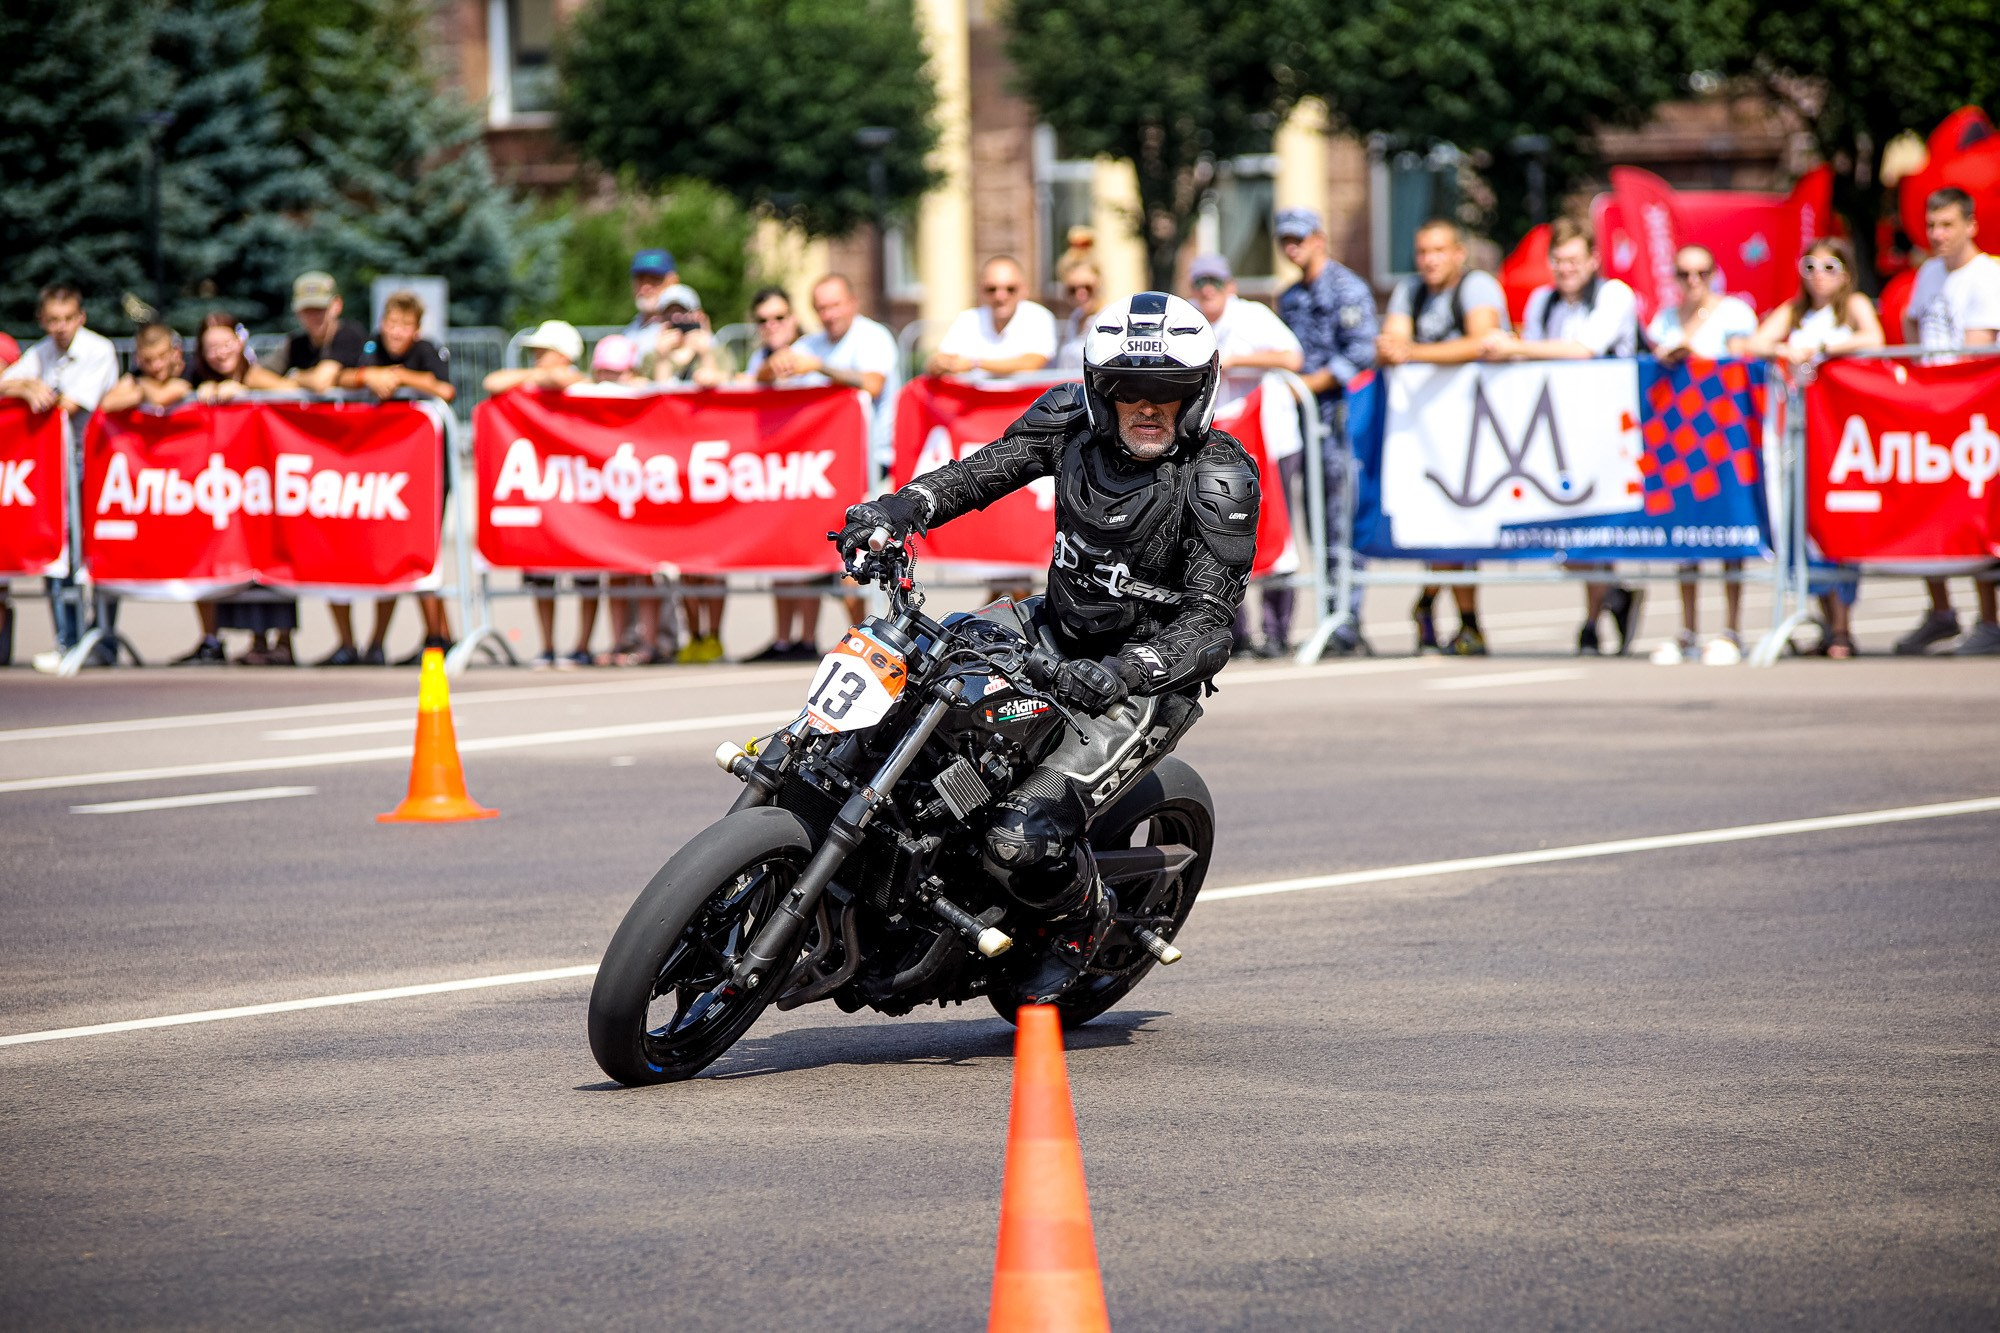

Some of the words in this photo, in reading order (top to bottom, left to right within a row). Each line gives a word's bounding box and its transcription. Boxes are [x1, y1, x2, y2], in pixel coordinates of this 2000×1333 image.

[1127, 340, 1162, 353] SHOEI
[0, 458, 36, 507] к
[492, 437, 682, 519] Альфа
[687, 440, 837, 502] Банк
[870, 652, 904, 679] 67
[808, 661, 867, 720] 13
